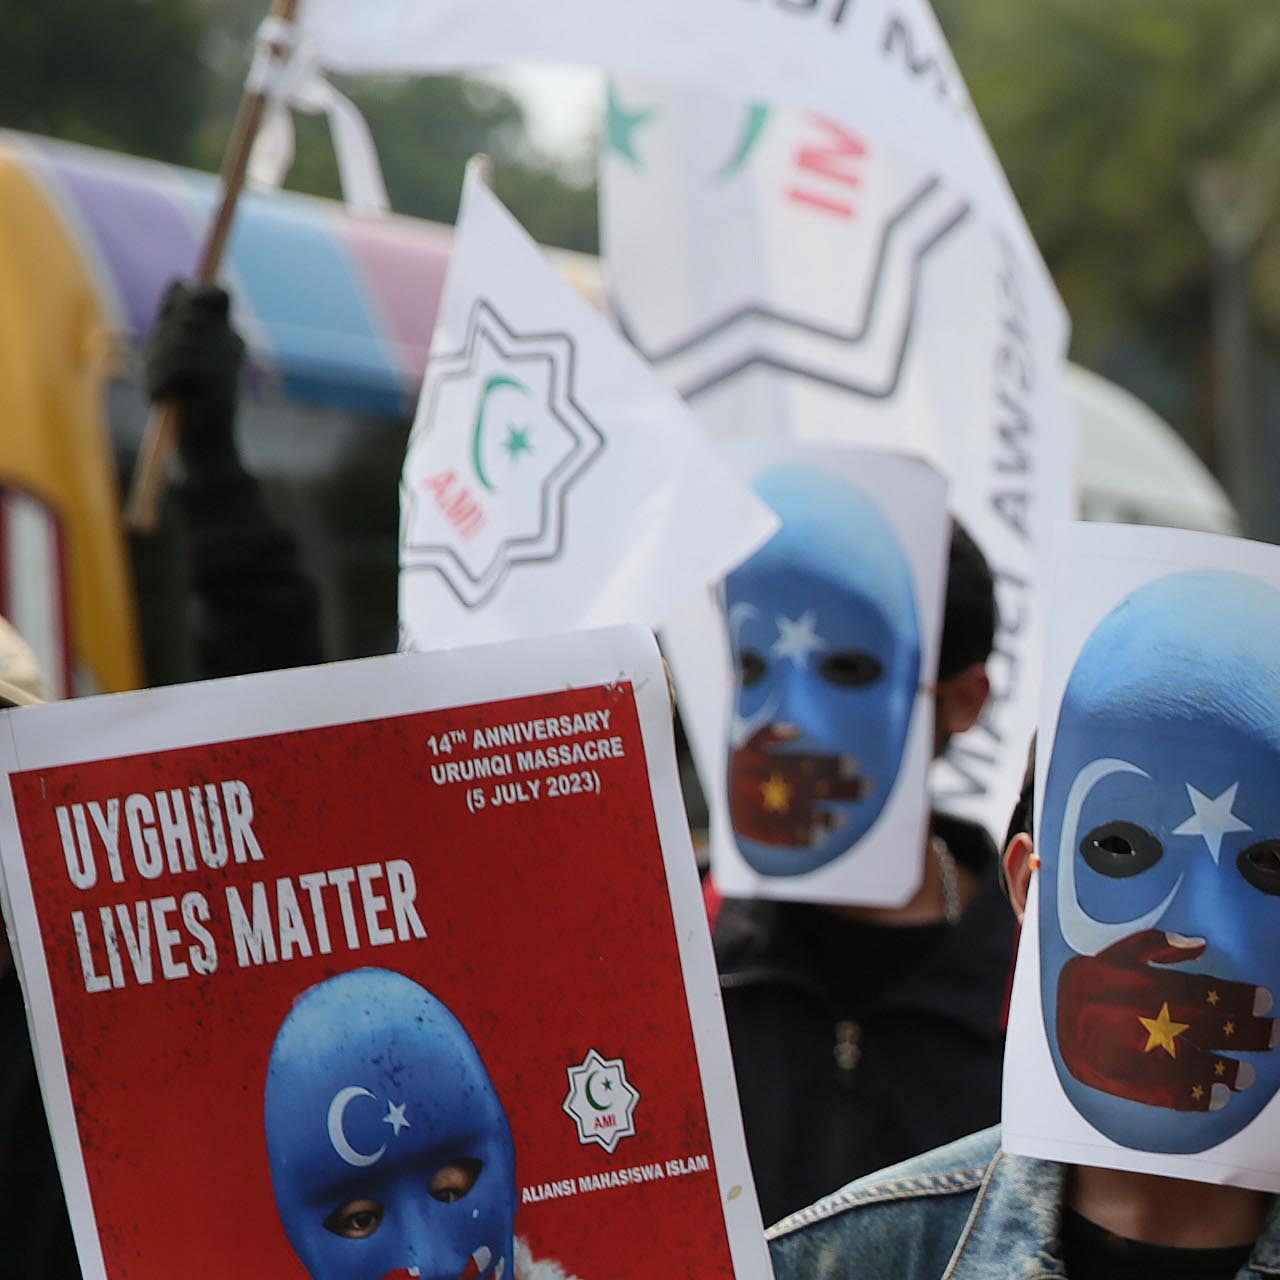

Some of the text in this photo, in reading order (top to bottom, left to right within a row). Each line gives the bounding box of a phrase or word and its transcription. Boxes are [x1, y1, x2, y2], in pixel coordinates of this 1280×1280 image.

[472, 708, 613, 751] ANNIVERSARY
[431, 736, 625, 785] URUMQI MASSACRE
[466, 769, 602, 814] (5 JULY 2023)
[54, 779, 265, 890] UYGHUR
[70, 858, 428, 993] LIVES MATTER
[593, 1113, 618, 1130] AMI
[521, 1154, 710, 1204] ALIANSI MAHASISWA ISLAM
